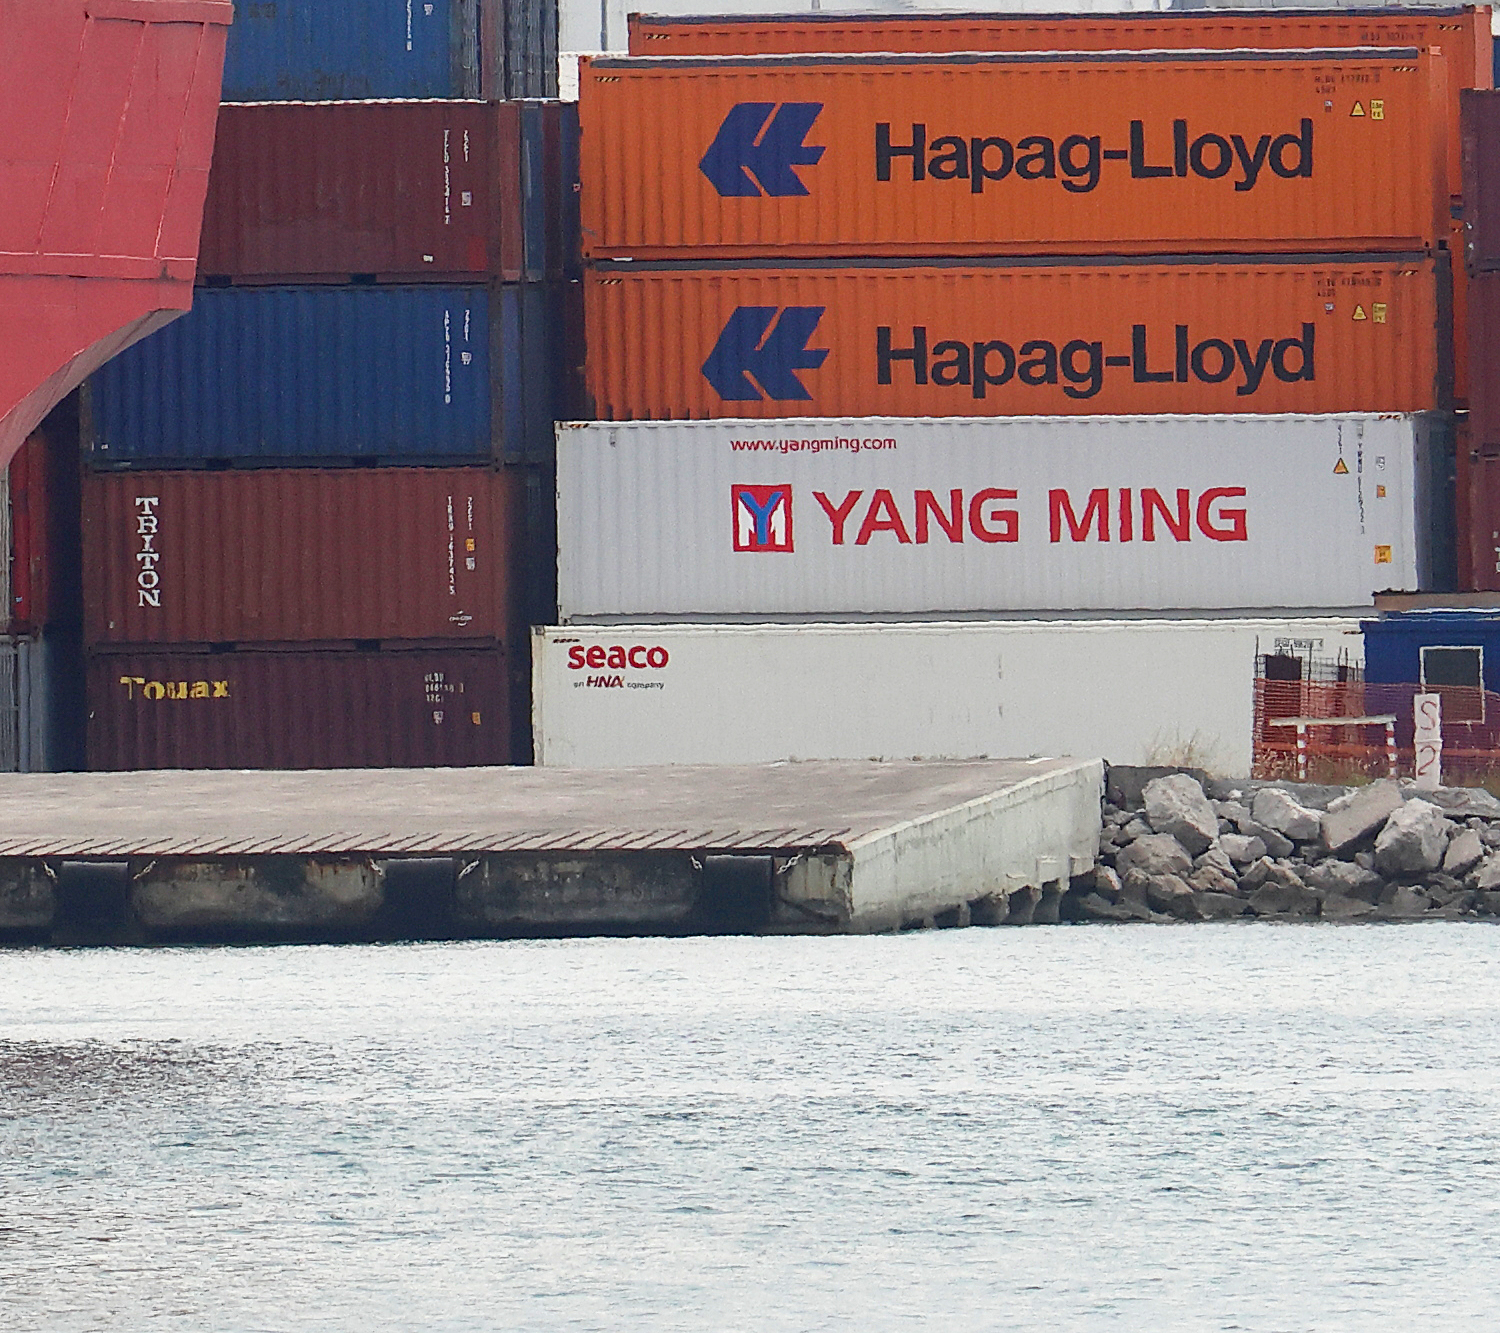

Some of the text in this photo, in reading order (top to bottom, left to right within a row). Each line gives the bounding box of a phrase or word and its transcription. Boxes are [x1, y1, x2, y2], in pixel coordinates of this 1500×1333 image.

[874, 119, 1314, 194] Hapag-Lloyd
[876, 322, 1316, 398] Hapag-Lloyd
[729, 435, 898, 454] www.yangming.com
[811, 485, 1249, 546] YANG MING
[134, 496, 162, 608] TRITON
[567, 644, 670, 670] seaco
[120, 675, 231, 700] Touax
[585, 674, 625, 689] HNA
